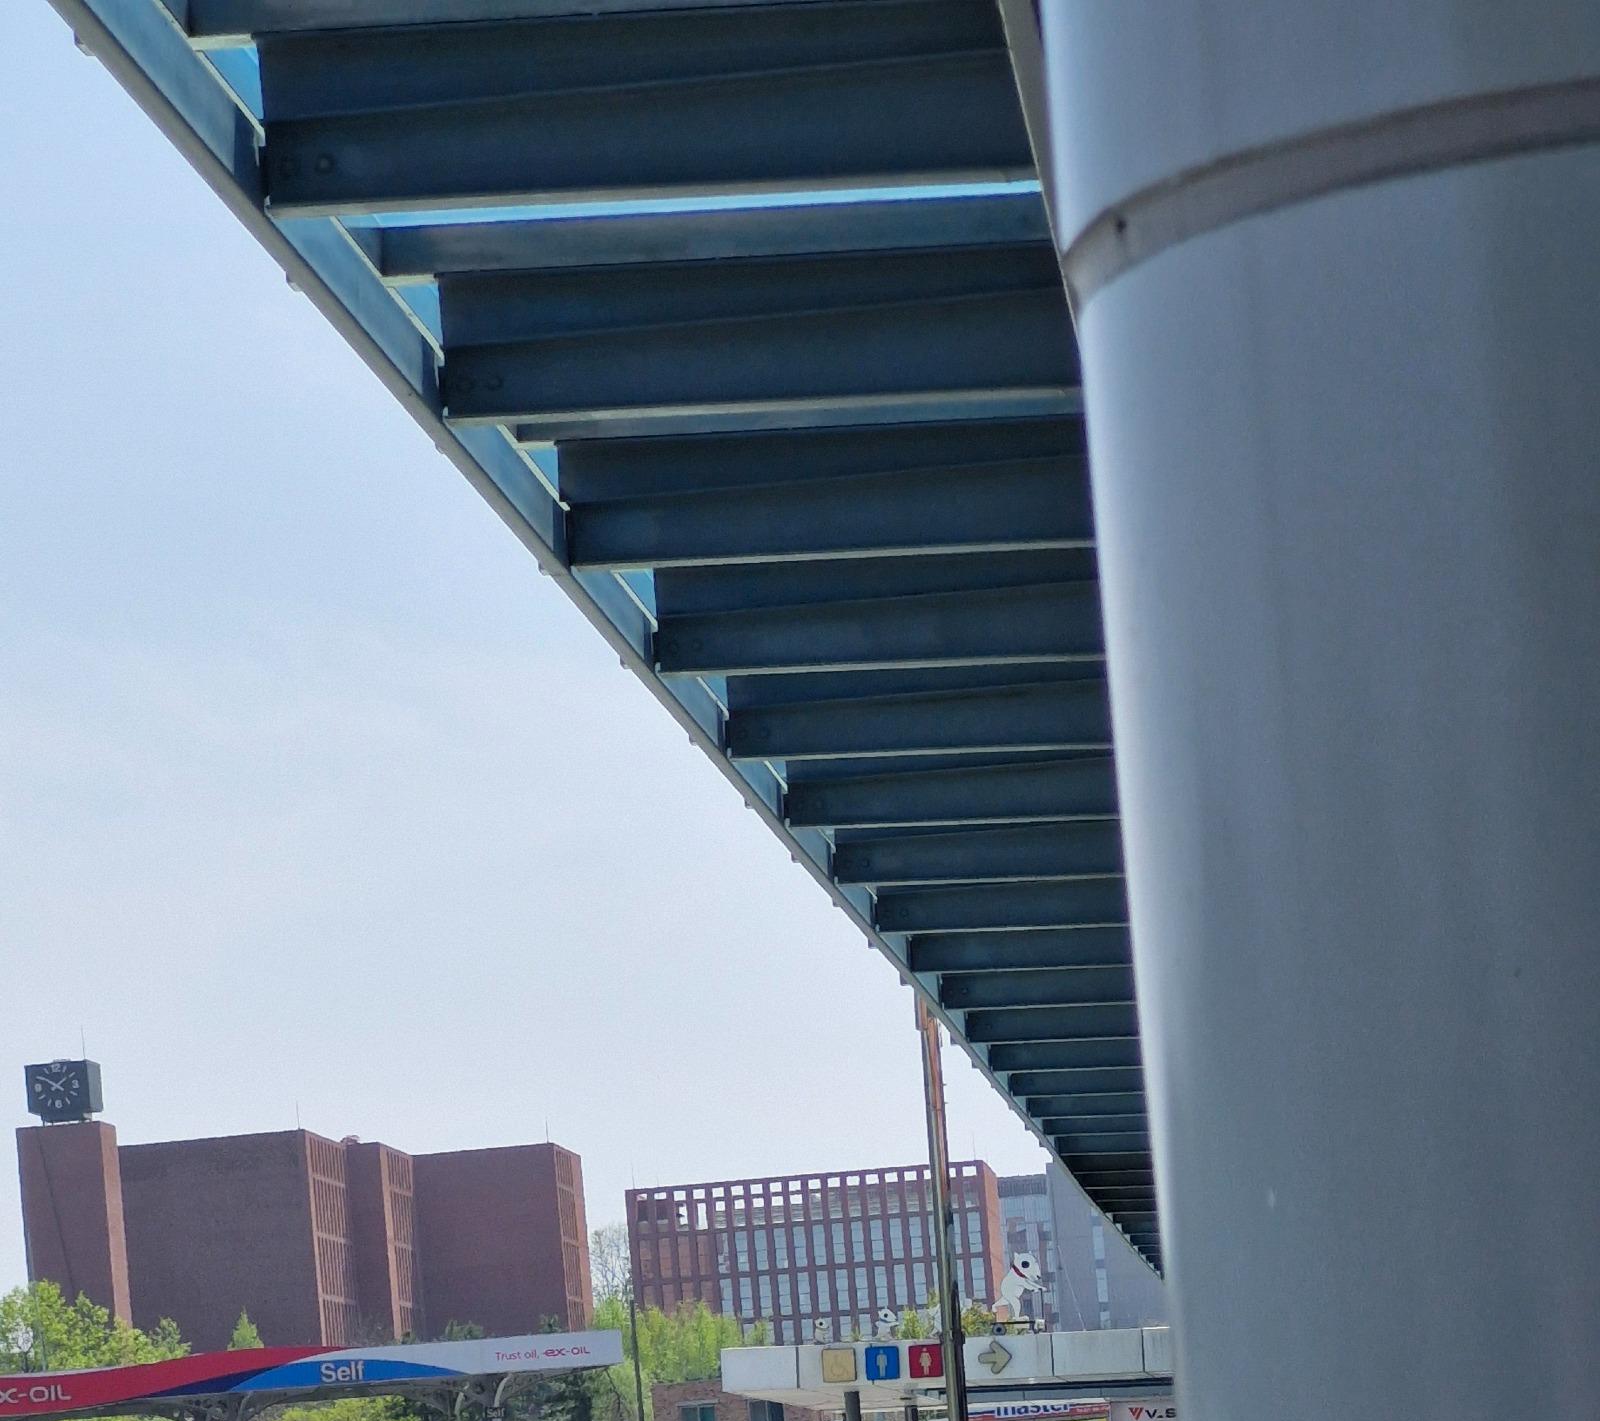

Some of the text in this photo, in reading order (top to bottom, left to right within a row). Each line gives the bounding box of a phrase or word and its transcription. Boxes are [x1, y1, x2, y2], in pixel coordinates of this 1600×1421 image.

[495, 1351, 521, 1361] Trust
[320, 1360, 365, 1383] Self
[0, 1384, 72, 1404] x-OIL
